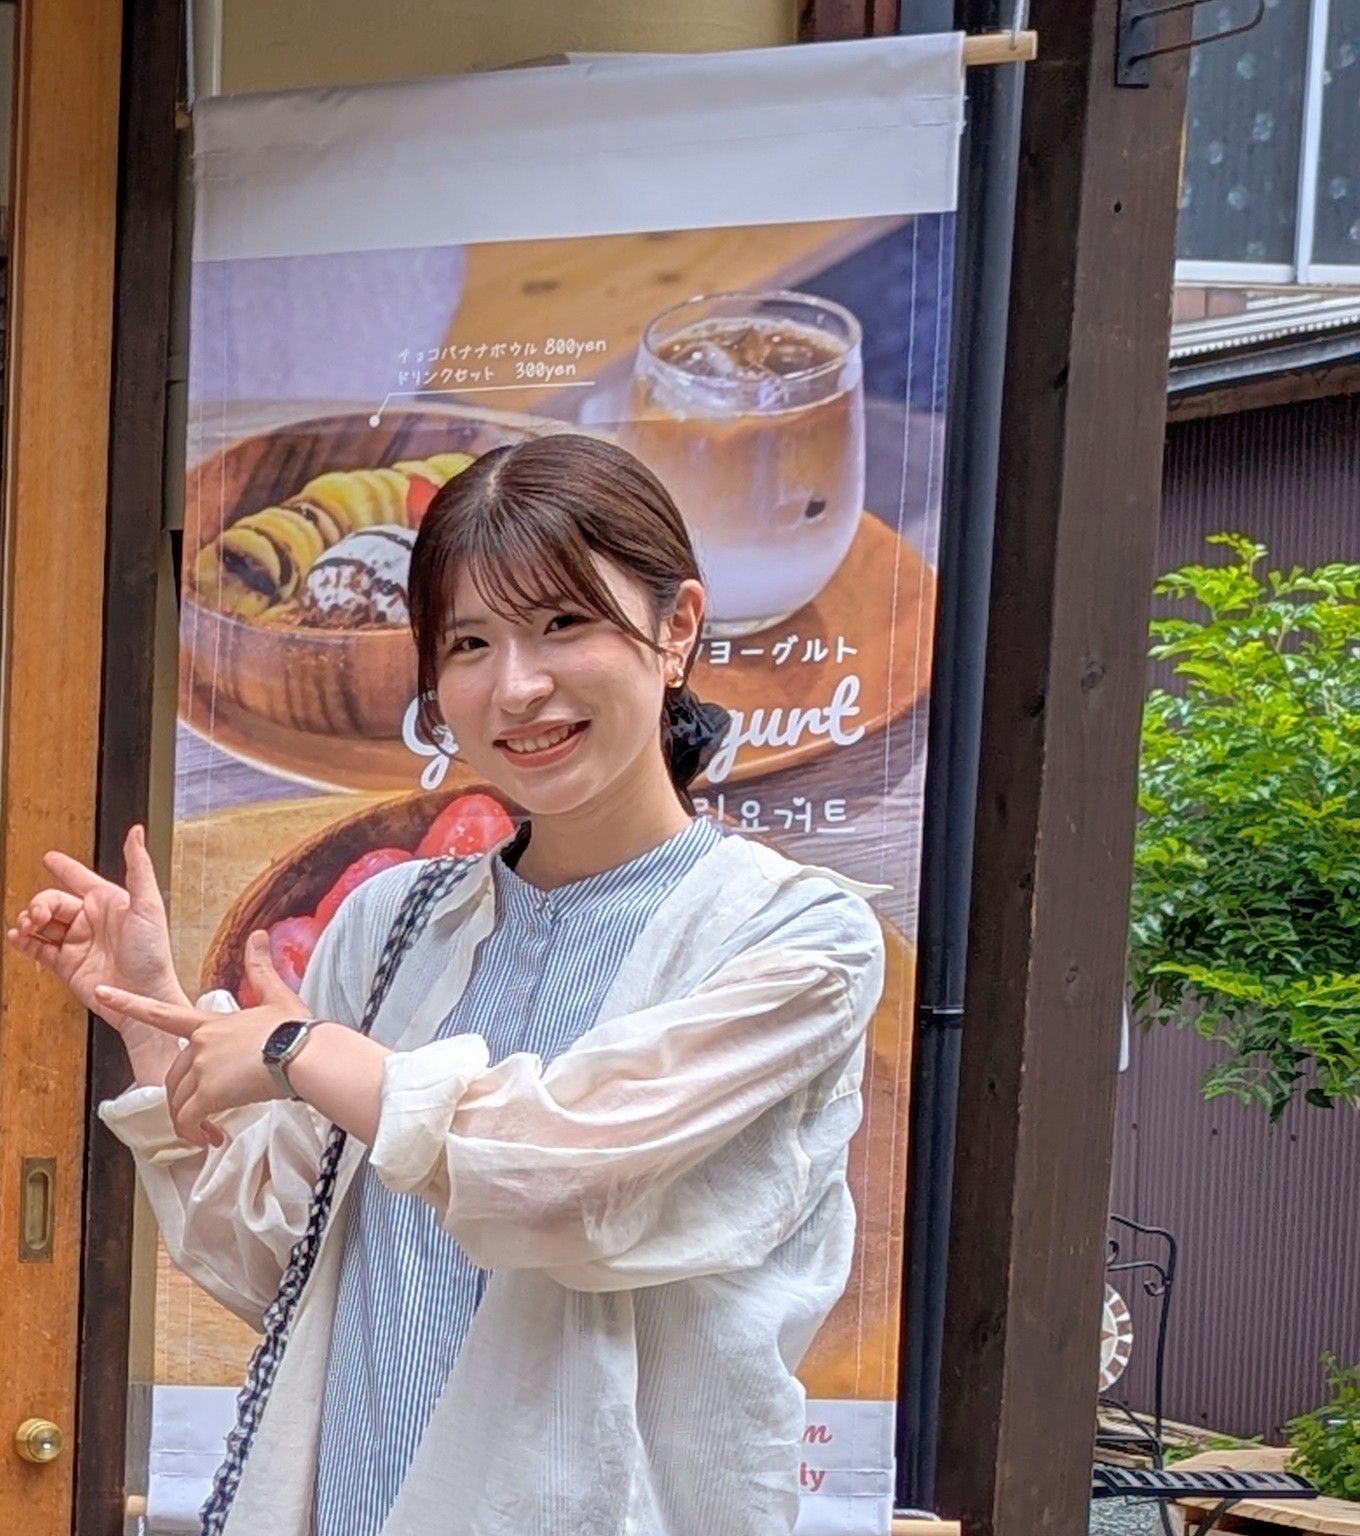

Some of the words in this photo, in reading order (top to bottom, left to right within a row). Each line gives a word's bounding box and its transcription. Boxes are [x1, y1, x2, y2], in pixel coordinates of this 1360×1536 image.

[397, 343, 538, 364] チョコバナナボウル
[543, 337, 607, 359] 800yen
[397, 367, 495, 387] ドリンクセット
[515, 362, 577, 382] 300yen
[694, 635, 858, 665] ヨーグルト
[706, 674, 865, 783] gurt
